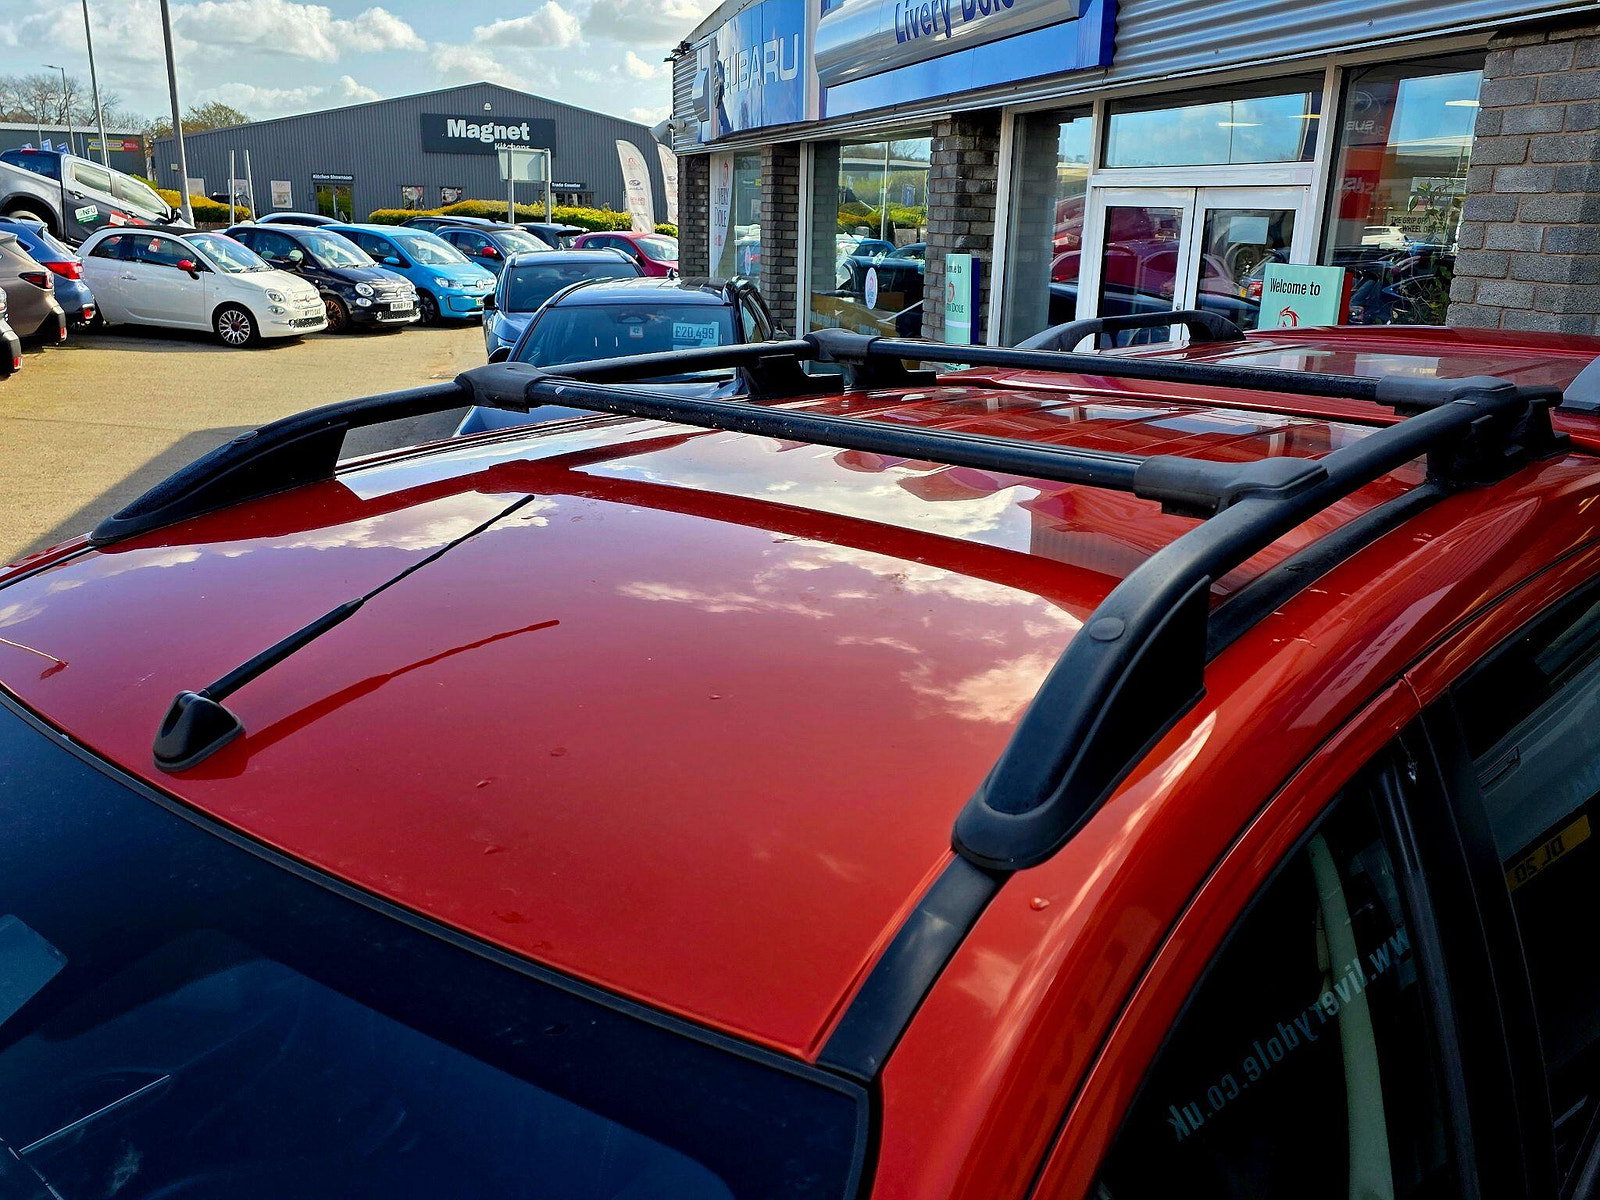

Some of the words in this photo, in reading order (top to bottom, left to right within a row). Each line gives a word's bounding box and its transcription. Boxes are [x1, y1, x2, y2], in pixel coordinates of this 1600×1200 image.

[894, 0, 951, 44] Livery
[962, 0, 1014, 22] Do
[724, 33, 799, 95] SUBARU
[446, 118, 530, 143] Magnet
[1270, 278, 1307, 295] Welcome
[1309, 281, 1321, 296] to
[675, 326, 715, 340] £20,499
